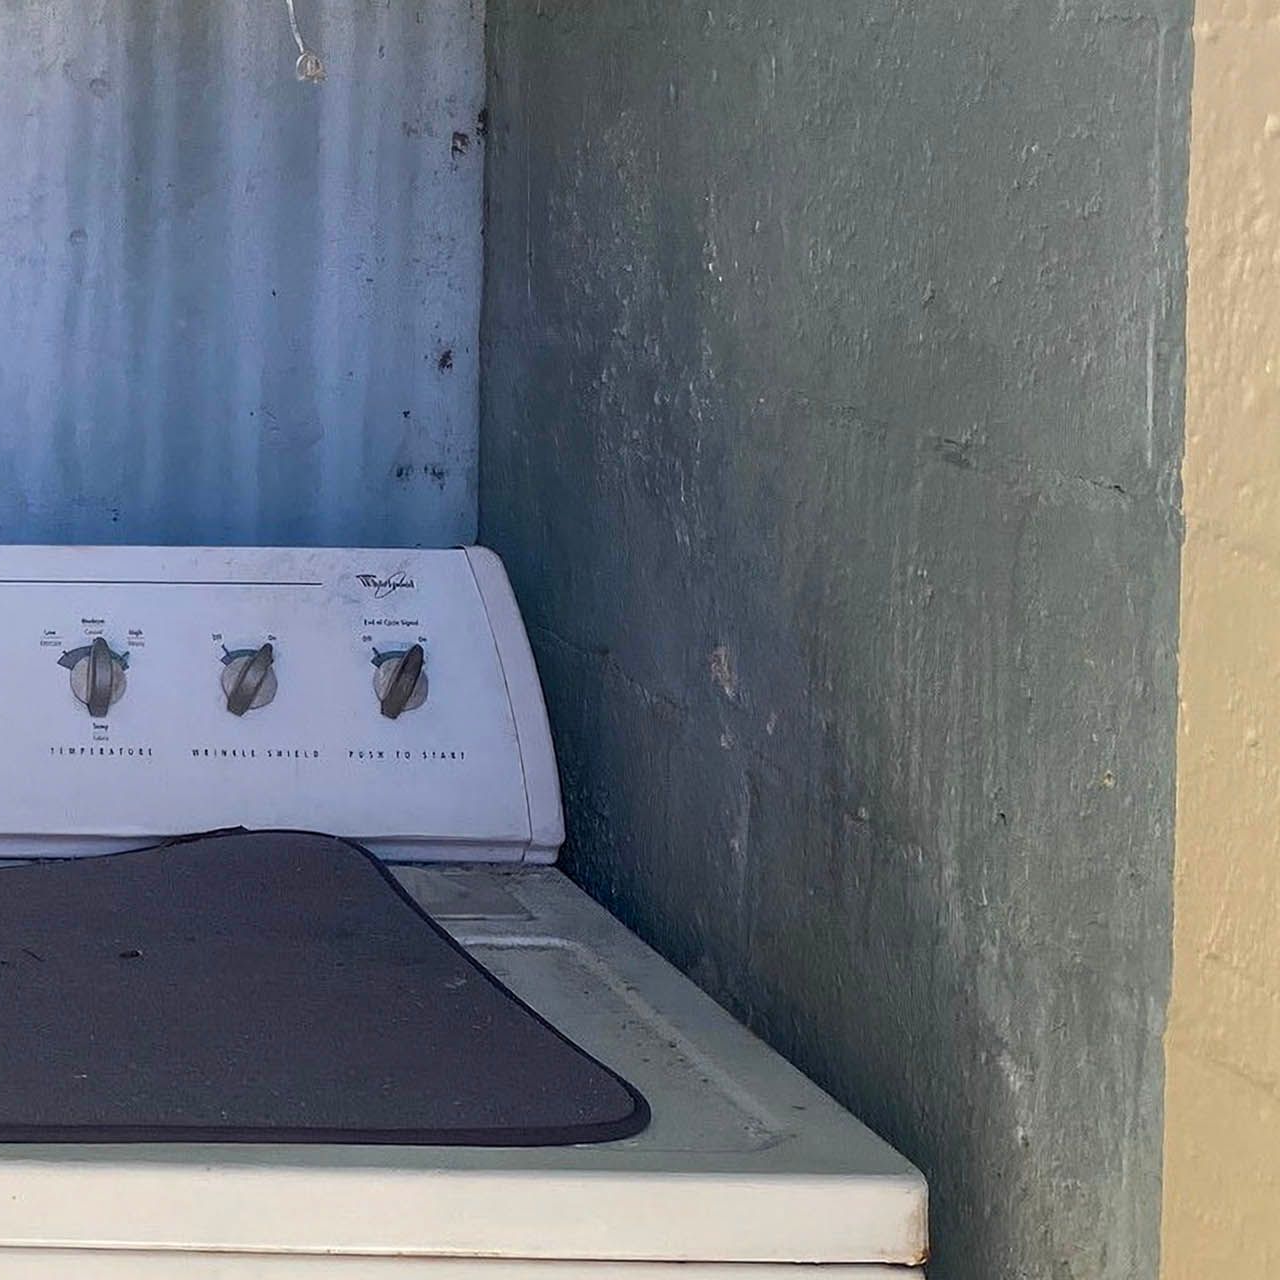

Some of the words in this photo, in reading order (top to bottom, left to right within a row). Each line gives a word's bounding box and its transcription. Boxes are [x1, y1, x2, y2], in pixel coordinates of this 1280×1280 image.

[355, 571, 415, 599] Whirlpool
[191, 748, 256, 758] WRINKLE
[266, 749, 319, 759] SHIELD
[348, 749, 384, 759] PUSH
[395, 750, 411, 759] TO
[421, 750, 465, 761] START
